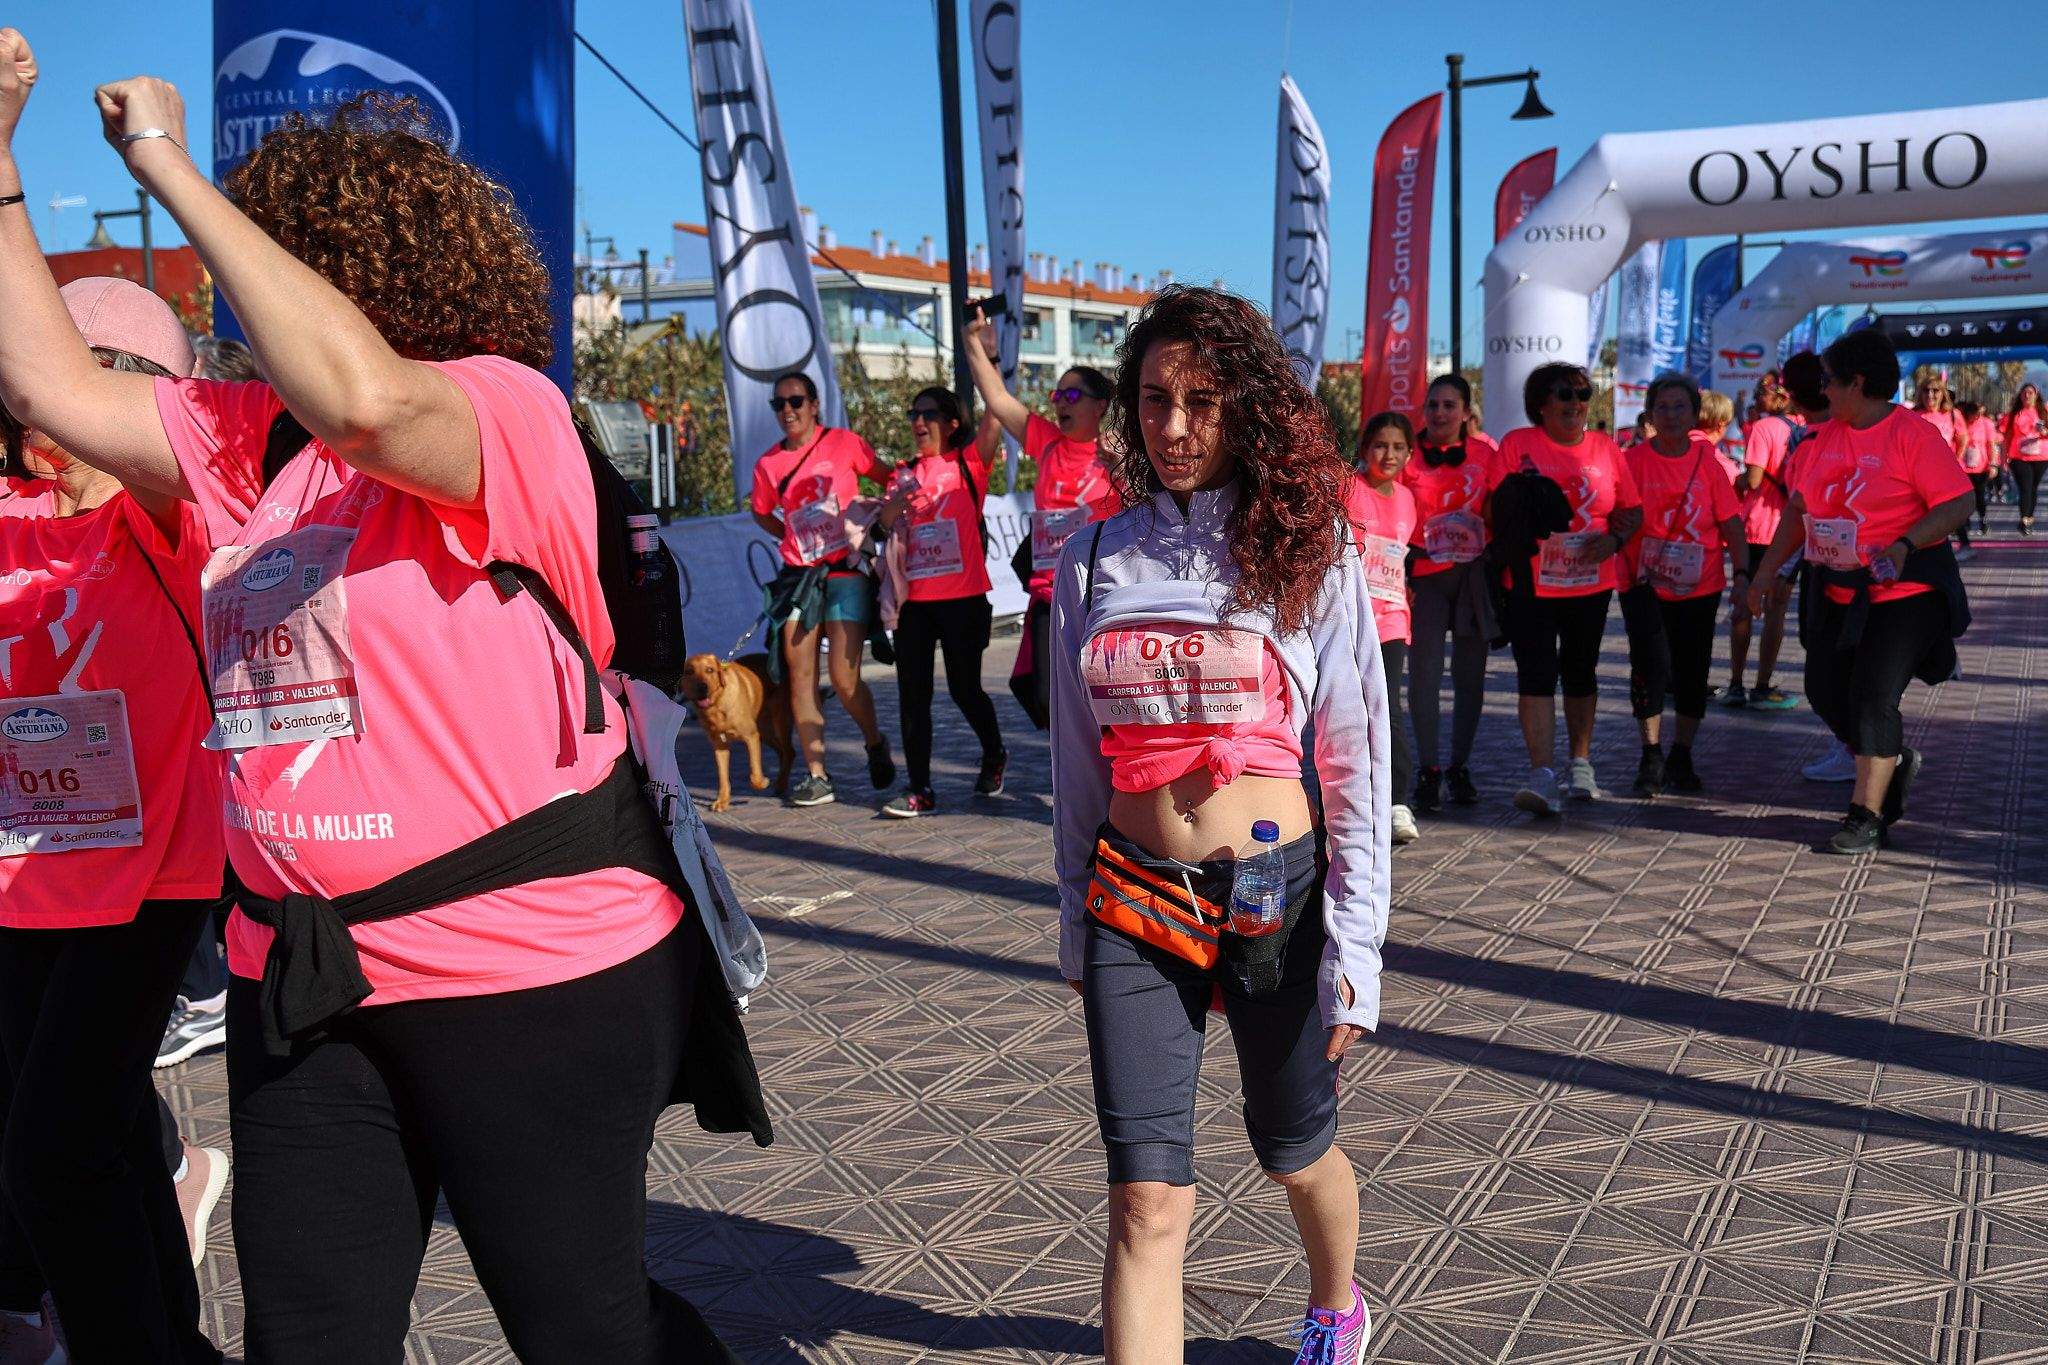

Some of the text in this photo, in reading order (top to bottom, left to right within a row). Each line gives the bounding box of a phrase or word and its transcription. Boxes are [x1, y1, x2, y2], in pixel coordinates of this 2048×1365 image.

[1688, 131, 1988, 207] OYSHO
[691, 0, 815, 383] OYSH
[1389, 144, 1421, 293] Santander
[1525, 224, 1607, 243] OYSHO
[1905, 318, 2034, 338] VOLVO
[1489, 335, 1562, 354] OYSHO
[919, 545, 942, 556] 016
[1817, 546, 1839, 557] 016
[1382, 565, 1401, 578] 016
[242, 624, 293, 662] 016
[1140, 633, 1205, 661] 016
[252, 670, 275, 687] 7989
[1154, 666, 1185, 679] 8000
[240, 695, 251, 706] DE
[252, 694, 261, 705] LA
[262, 690, 285, 703] MUJER
[292, 684, 338, 700] VALENCIA
[1107, 686, 1141, 697] CARRERA
[1143, 685, 1154, 694] DE
[1156, 684, 1167, 693] LA
[1199, 681, 1238, 691] VALENCIA
[1110, 703, 1160, 716] OYSHO
[7, 722, 66, 735] ASTURIANA
[219, 711, 346, 736] SHO Santander
[19, 767, 80, 794] 016
[32, 800, 65, 810] 8008
[17, 815, 27, 823] DE
[41, 813, 69, 822] MUJER
[76, 812, 117, 821] VALENCIA
[256, 809, 279, 837] DE
[282, 812, 309, 840] LA
[312, 813, 395, 841] MUJER
[65, 830, 121, 843] Santander
